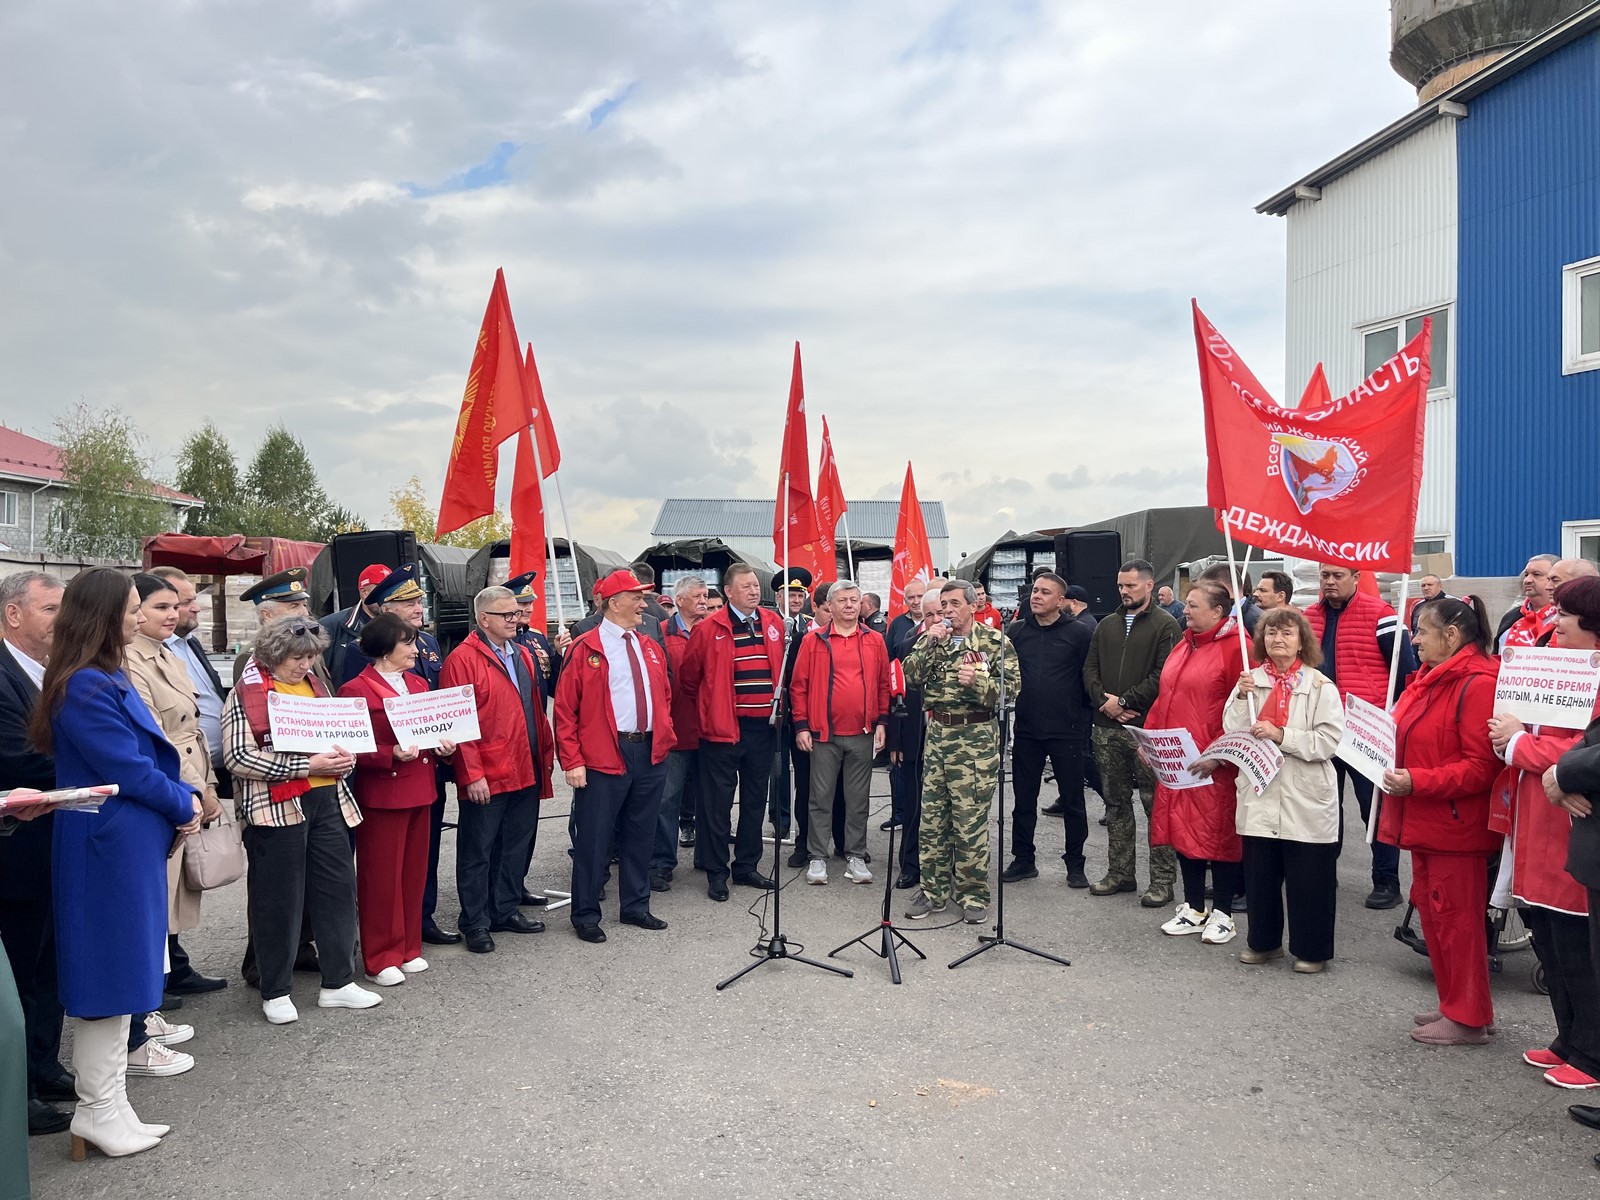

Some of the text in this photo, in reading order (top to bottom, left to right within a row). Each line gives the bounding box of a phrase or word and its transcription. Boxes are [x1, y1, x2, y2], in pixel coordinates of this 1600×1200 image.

[1220, 505, 1313, 550] ДЕЖДА
[1498, 676, 1555, 690] НАЛОГОВОЕ
[1556, 680, 1592, 693] БРЕМЯ
[1496, 690, 1595, 709] БОГАТЫМ, А НЕ БЕДНЫМ
[274, 716, 368, 729] ОСТАНОВИМ РОСТ ЦЕН,
[391, 714, 435, 728] БОГАТСТВА
[435, 707, 472, 721] РОССИИ
[277, 727, 314, 738] ДОЛГОВ
[315, 730, 323, 738] И
[324, 730, 369, 739] ТАРИФОВ
[411, 722, 453, 736] НАРОДУ
[1149, 736, 1182, 747] ПРОТИВ
[1351, 737, 1357, 747] А
[1355, 741, 1364, 753] НЕ
[1223, 748, 1244, 761] МЕСТА
[1244, 757, 1250, 767] И
[1242, 744, 1250, 752] И
[1250, 750, 1271, 778] СЕЛАМ
